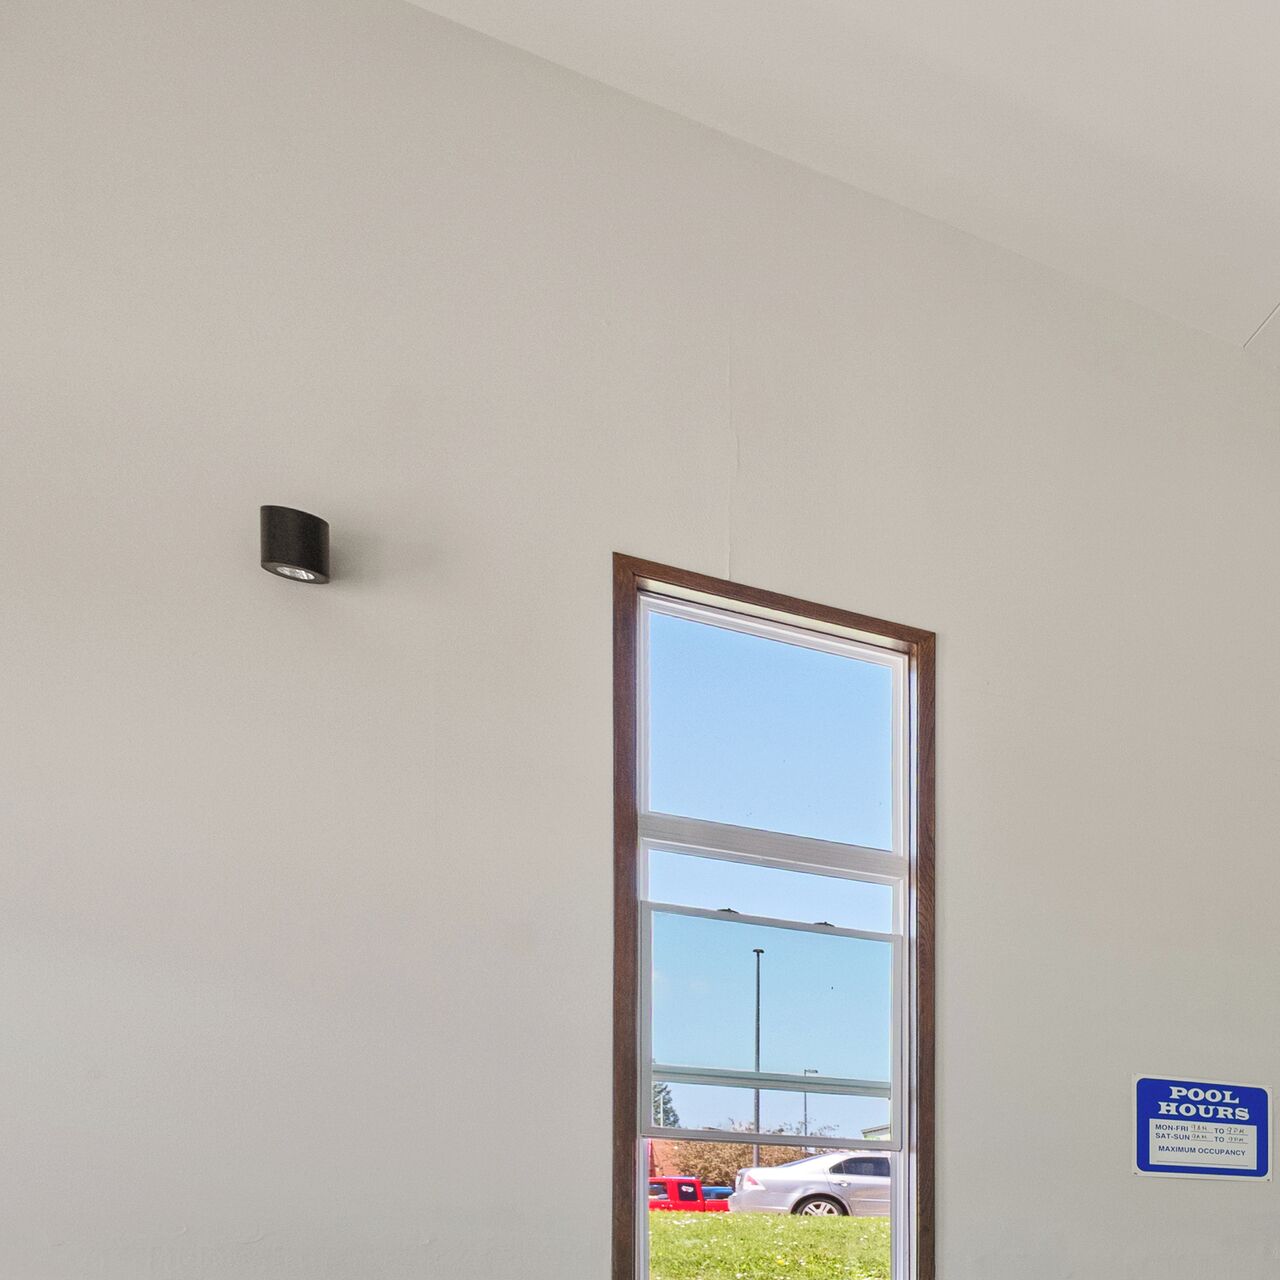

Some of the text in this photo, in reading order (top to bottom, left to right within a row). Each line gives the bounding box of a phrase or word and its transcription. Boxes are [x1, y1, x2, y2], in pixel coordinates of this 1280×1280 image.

[1169, 1086, 1239, 1104] POOL
[1158, 1101, 1250, 1120] HOURS
[1198, 1148, 1246, 1156] OCCUPANCY
